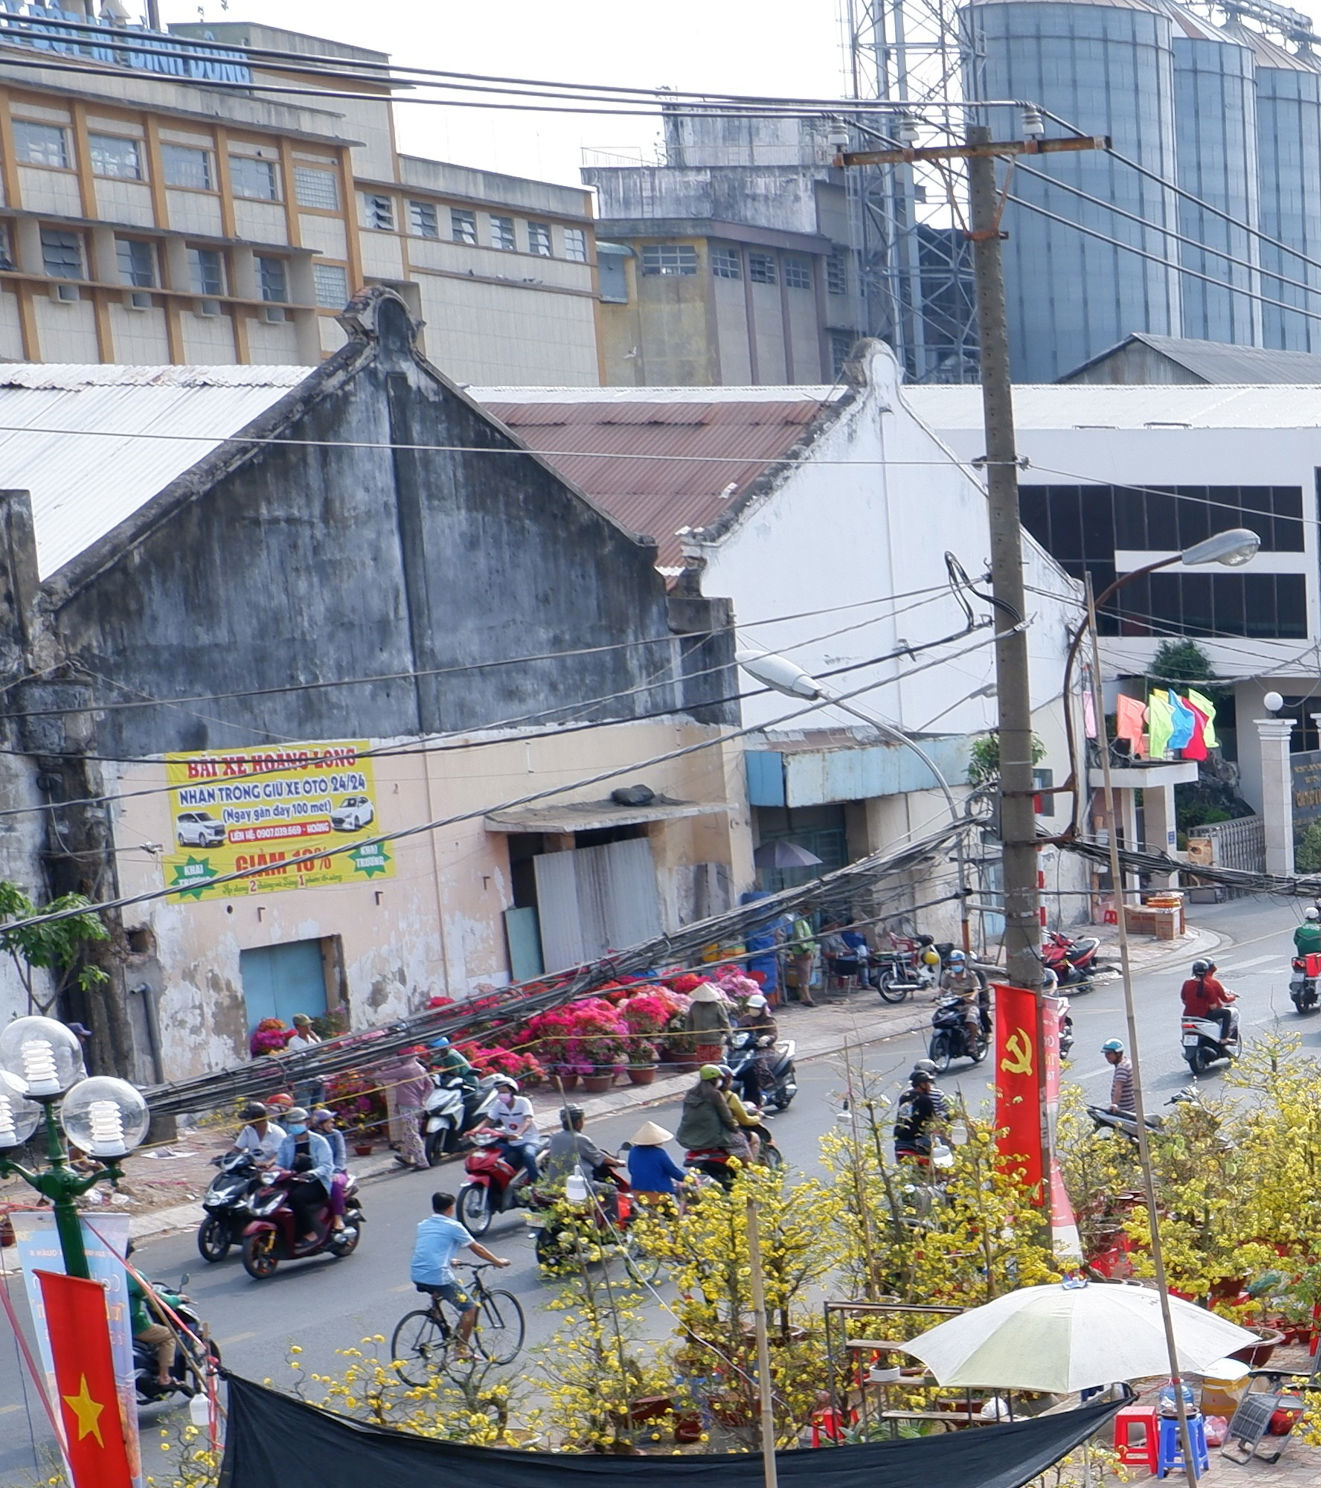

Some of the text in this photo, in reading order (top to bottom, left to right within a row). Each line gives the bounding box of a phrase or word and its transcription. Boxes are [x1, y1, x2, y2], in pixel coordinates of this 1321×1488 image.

[221, 756, 247, 776] XE
[251, 747, 308, 773] HOÀNG
[313, 748, 356, 769] LONG
[286, 781, 300, 797] XE
[330, 773, 365, 792] 24/24
[222, 808, 251, 824] (Ngay
[292, 803, 308, 815] 100
[291, 847, 332, 873] 10%
[249, 880, 257, 892] 2
[299, 875, 305, 886] 1
